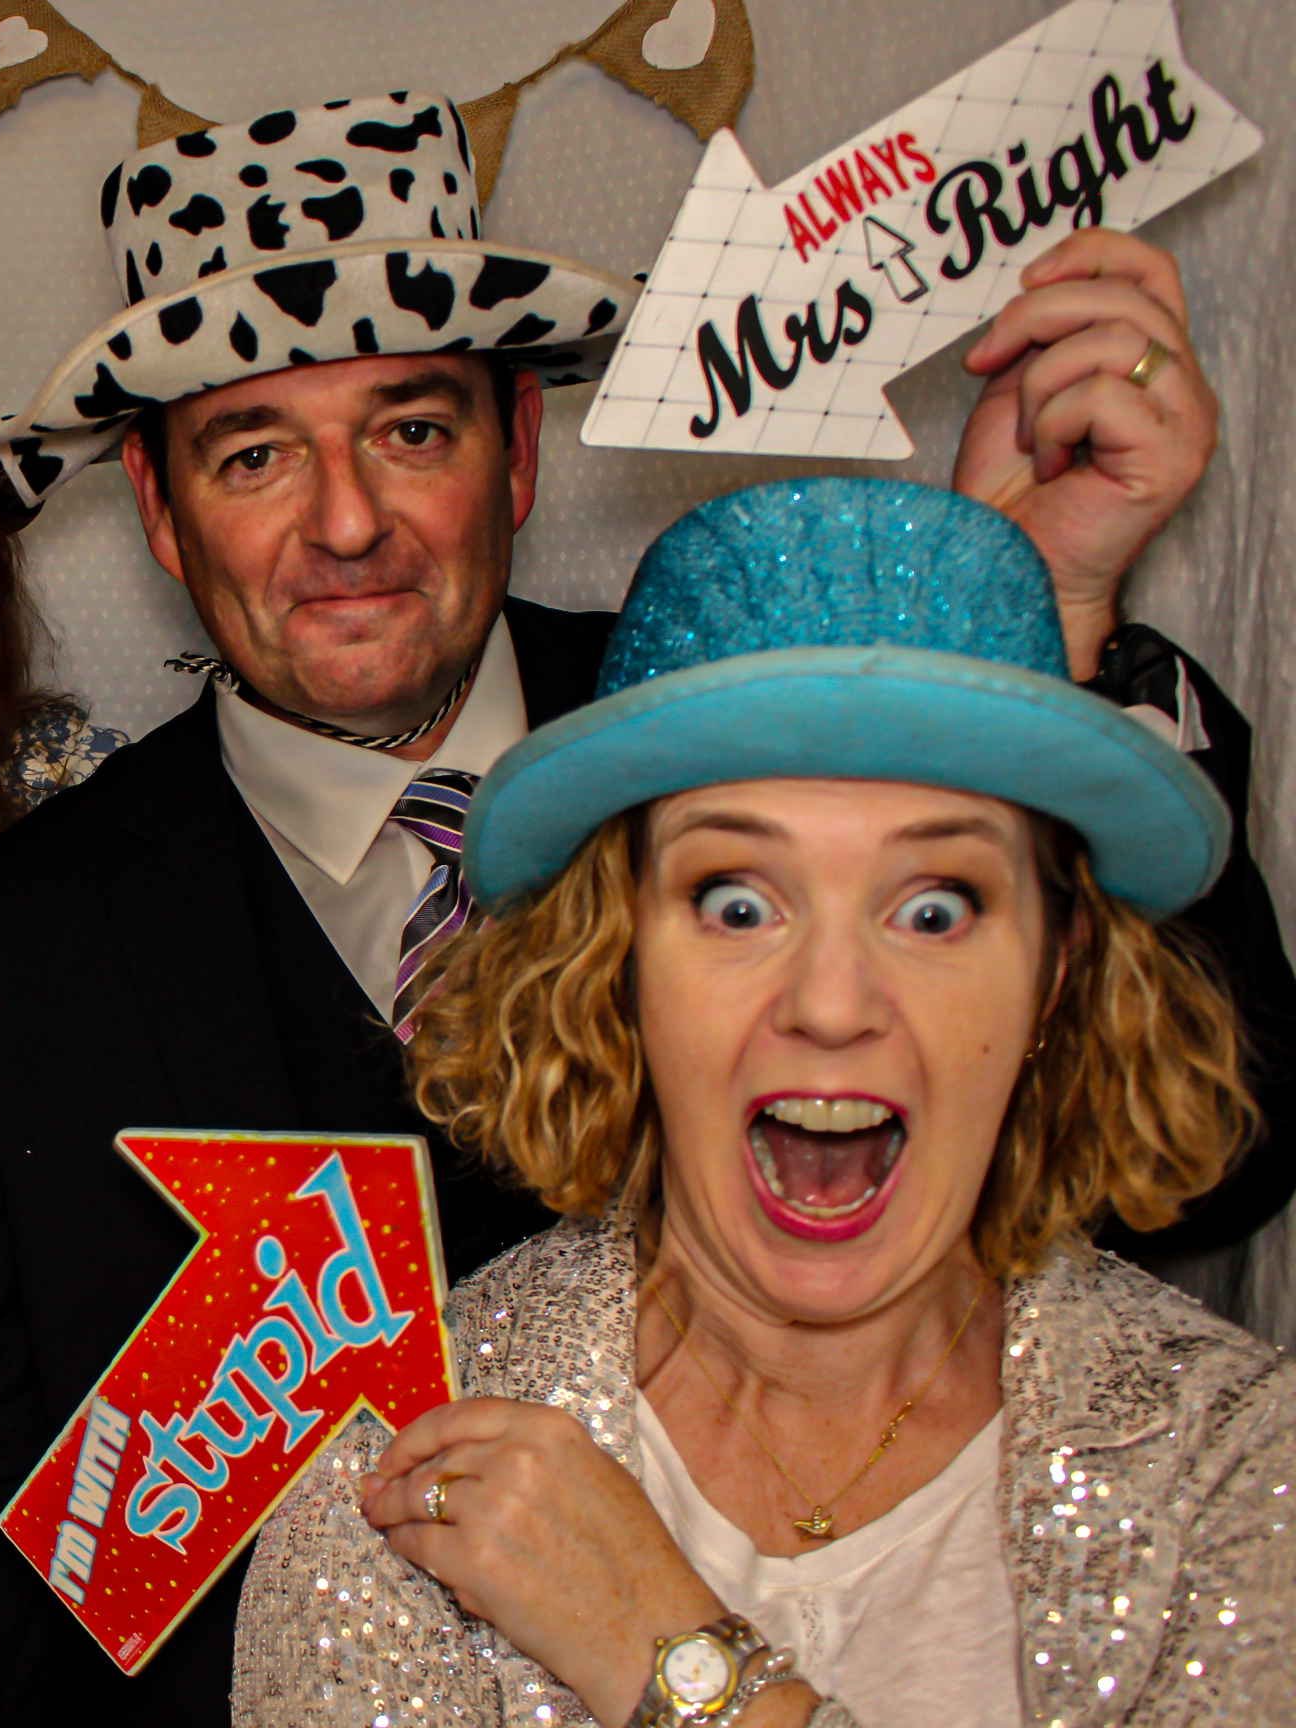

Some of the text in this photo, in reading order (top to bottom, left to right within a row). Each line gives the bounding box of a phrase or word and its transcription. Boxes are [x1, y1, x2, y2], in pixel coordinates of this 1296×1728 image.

[689, 60, 1195, 439] Mrs Right
[782, 131, 937, 264] ALWAYS
[67, 1396, 131, 1528] WITH
[125, 1150, 415, 1555] stupid
